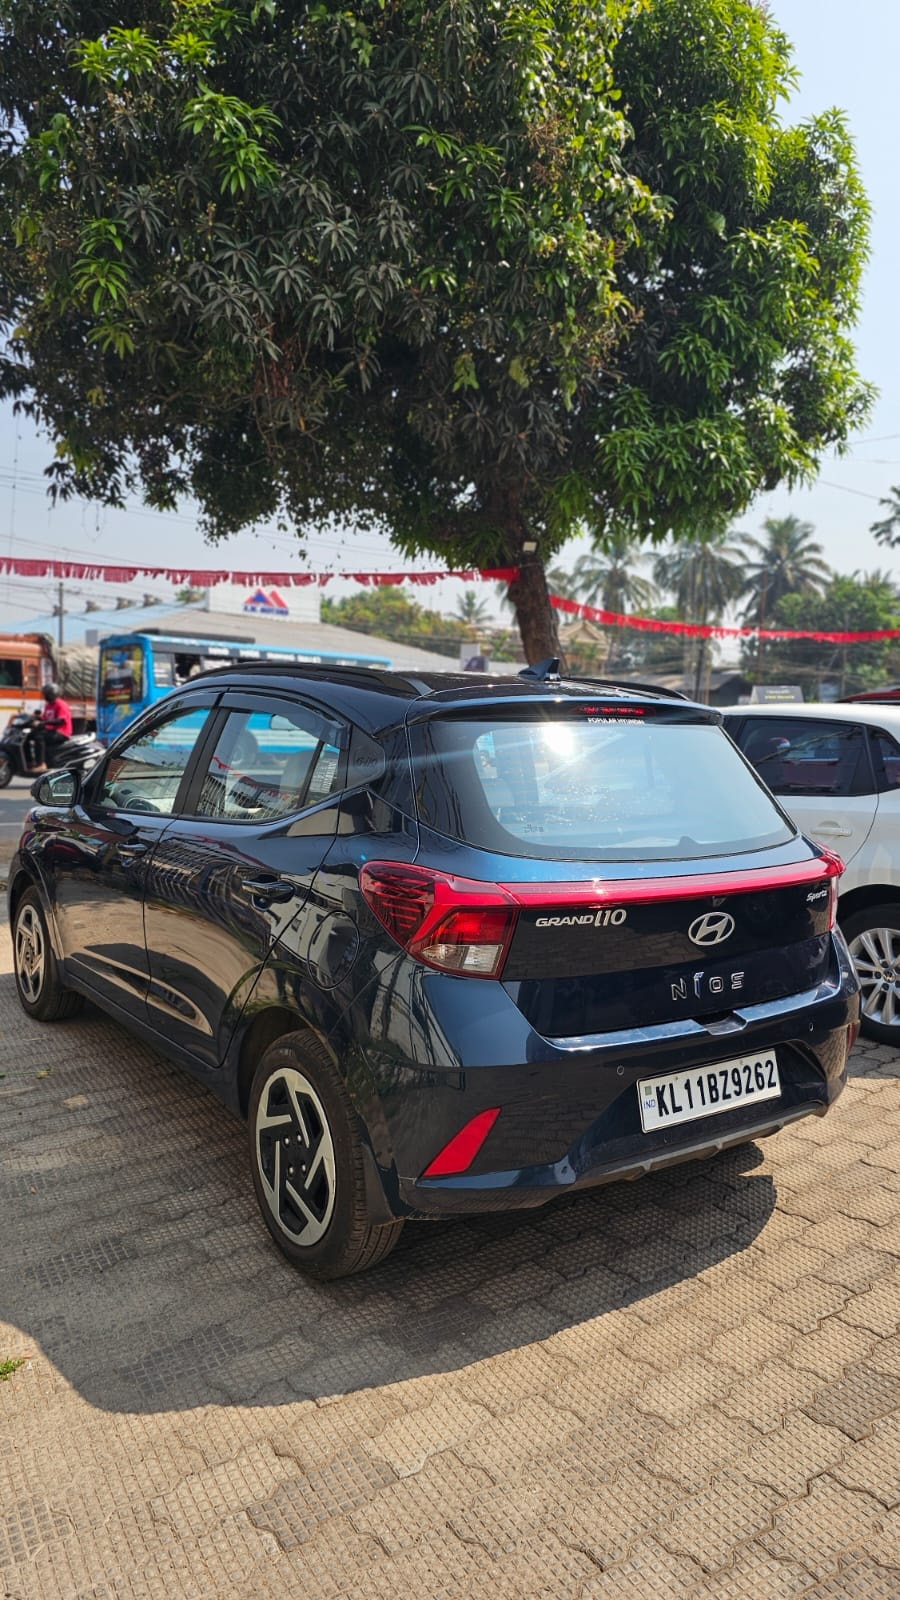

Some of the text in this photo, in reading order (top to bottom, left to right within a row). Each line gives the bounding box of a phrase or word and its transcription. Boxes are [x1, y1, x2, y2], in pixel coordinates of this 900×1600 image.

[535, 914, 594, 927] GRAND
[655, 1059, 777, 1118] KL11BZ9262
[643, 1098, 656, 1110] IND
